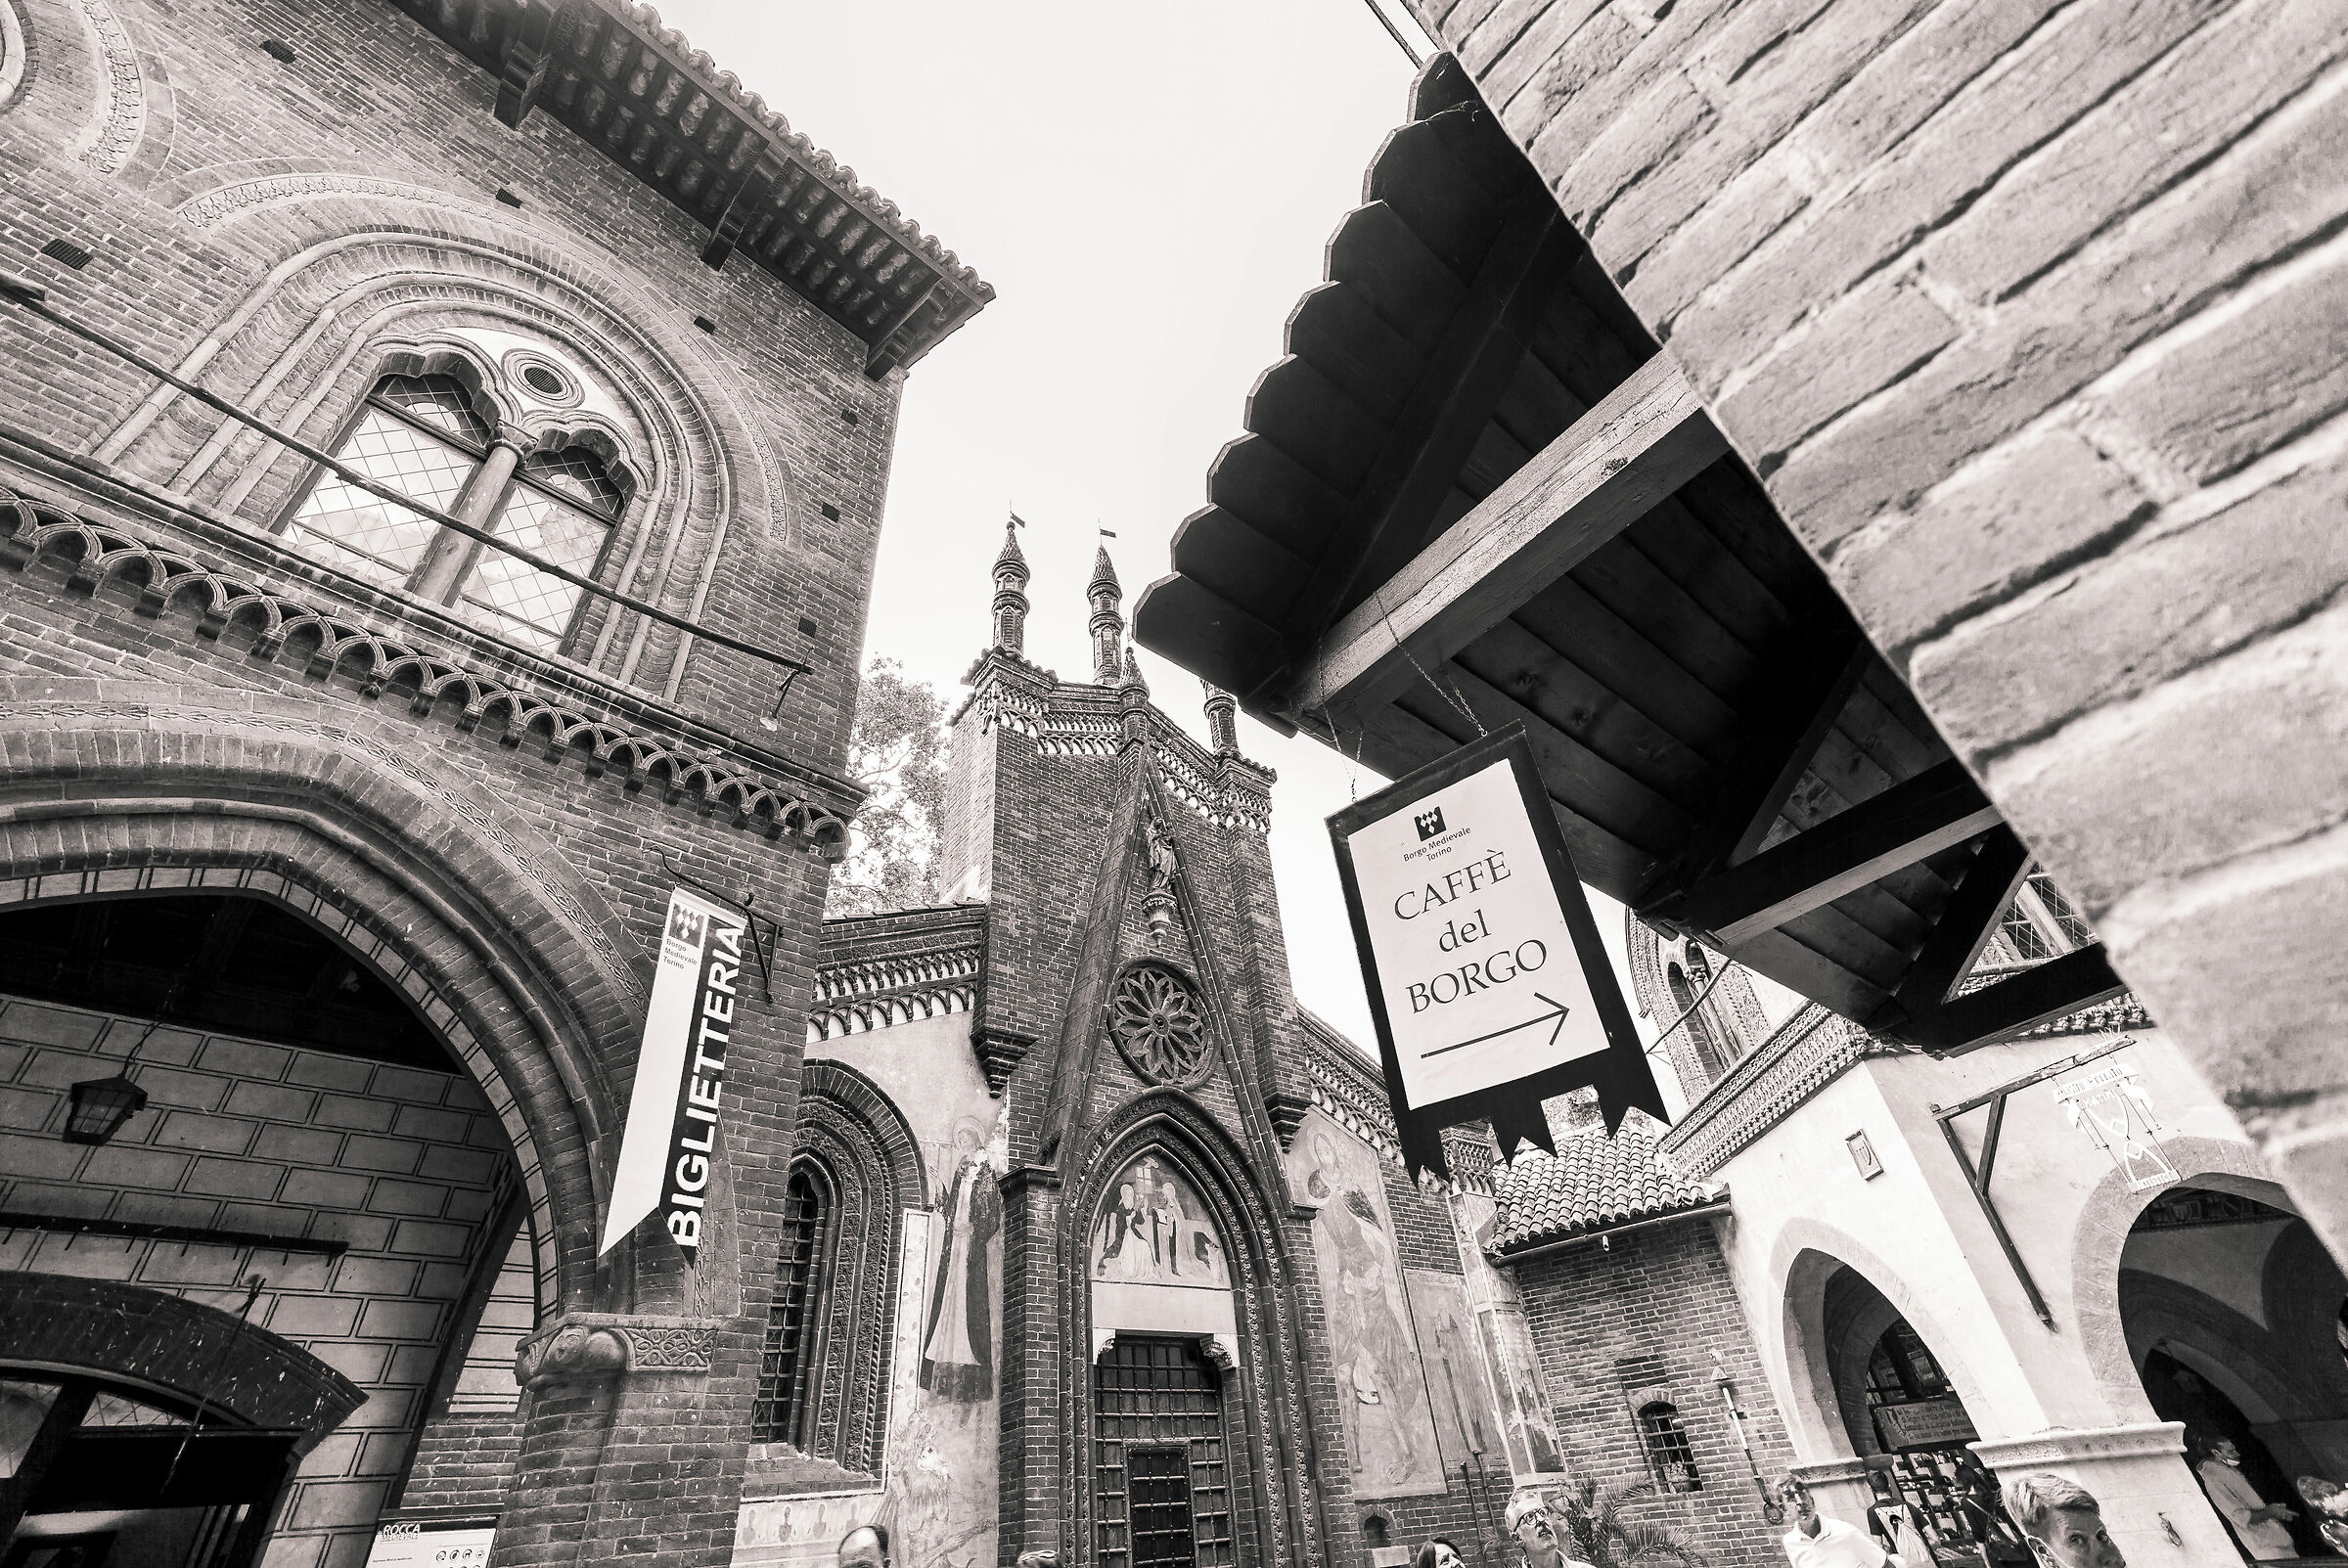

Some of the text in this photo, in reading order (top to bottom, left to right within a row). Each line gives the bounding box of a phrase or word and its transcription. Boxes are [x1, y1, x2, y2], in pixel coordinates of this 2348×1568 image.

[1403, 827, 1471, 862] Borgo Medievale
[1425, 846, 1453, 862] Torino
[1394, 849, 1512, 920] CAFFÈ
[1438, 908, 1492, 953] del
[664, 947, 698, 965] Medievale
[665, 939, 687, 952] Borgo
[663, 956, 685, 969] Torino
[1405, 939, 1547, 1013] BORGO
[667, 926, 745, 1247] BIGLIETTERIA
[384, 1524, 421, 1536] ROCCA
